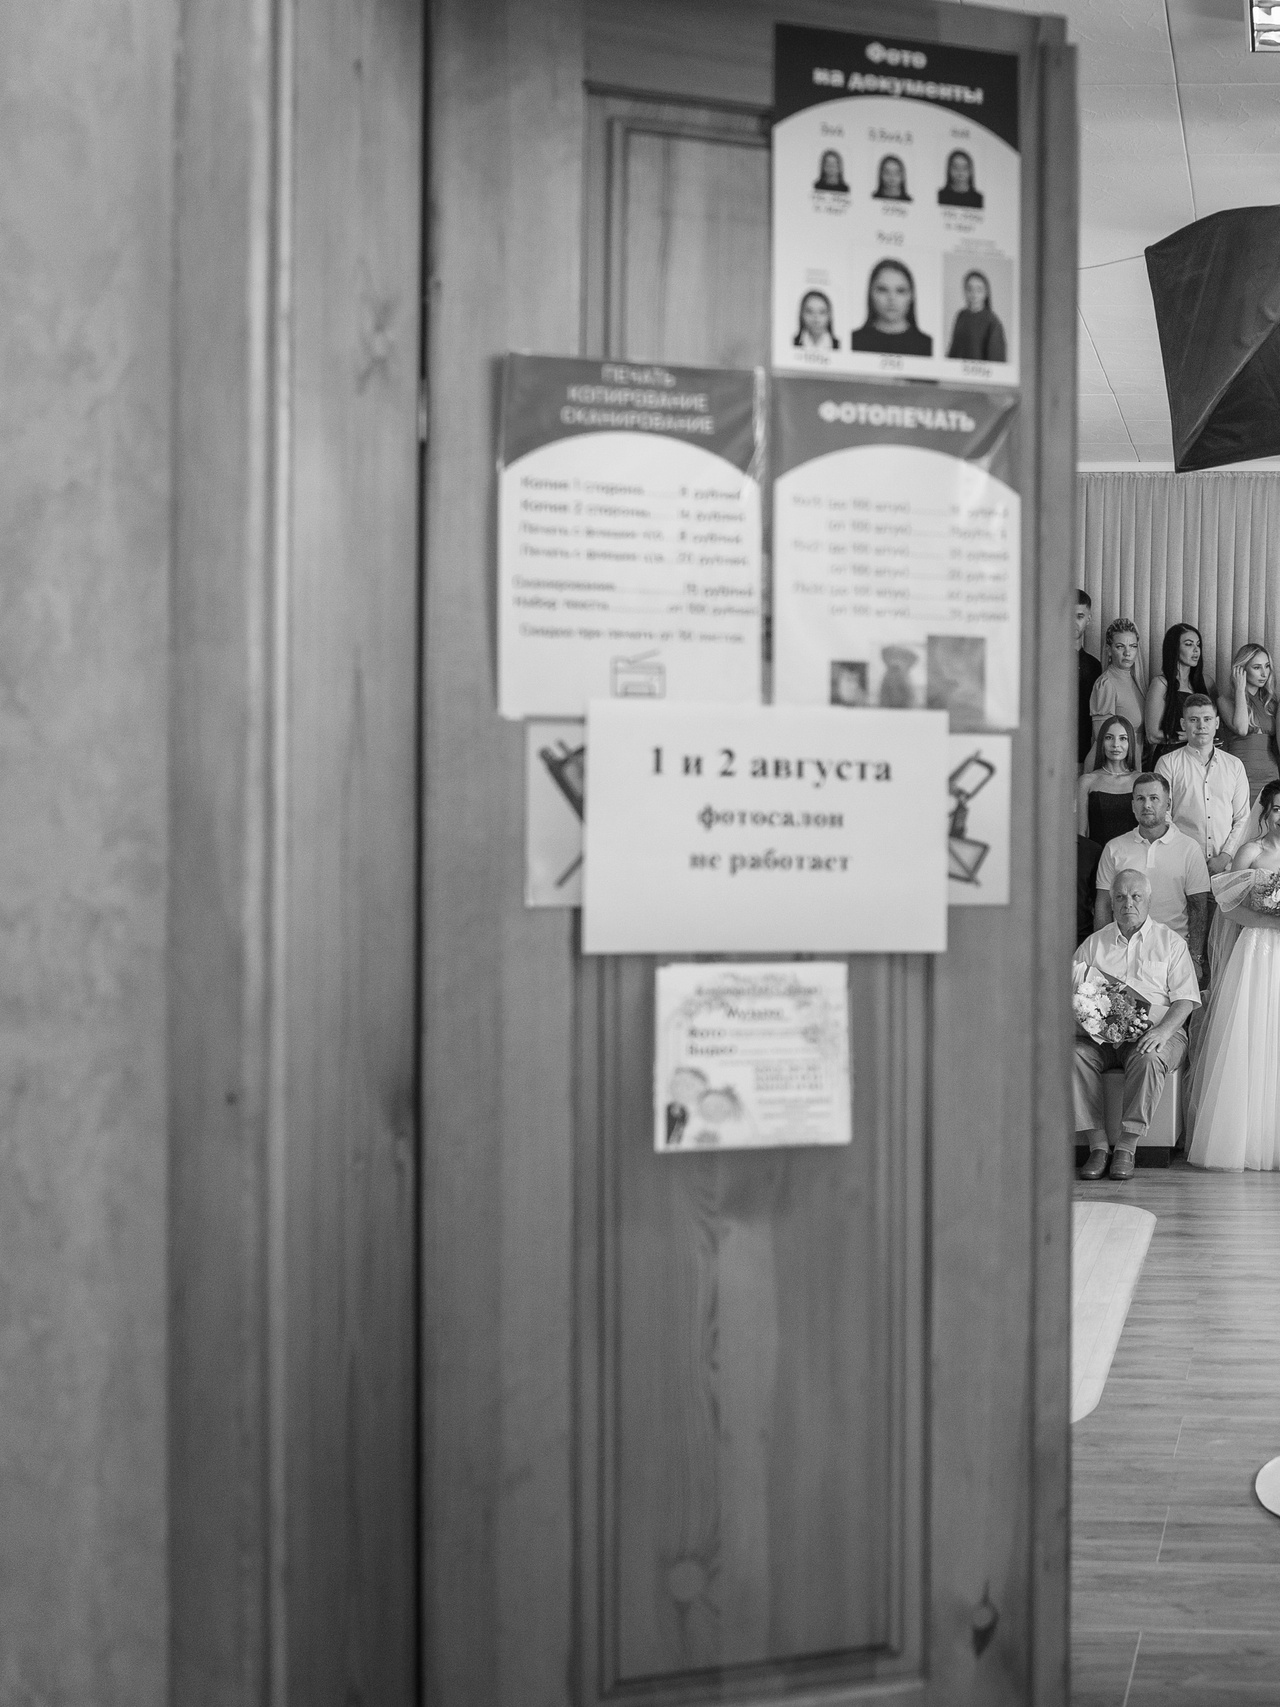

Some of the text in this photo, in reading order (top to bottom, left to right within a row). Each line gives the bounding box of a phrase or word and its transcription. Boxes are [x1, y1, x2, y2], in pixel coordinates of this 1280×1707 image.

[566, 384, 709, 413] КОПИРОВАНИЕ
[818, 399, 976, 433] ФОТОПЕЧАТЬ
[652, 746, 892, 789] 1 и 2 августа
[698, 804, 845, 832] фотосалон
[688, 848, 851, 876] не работает
